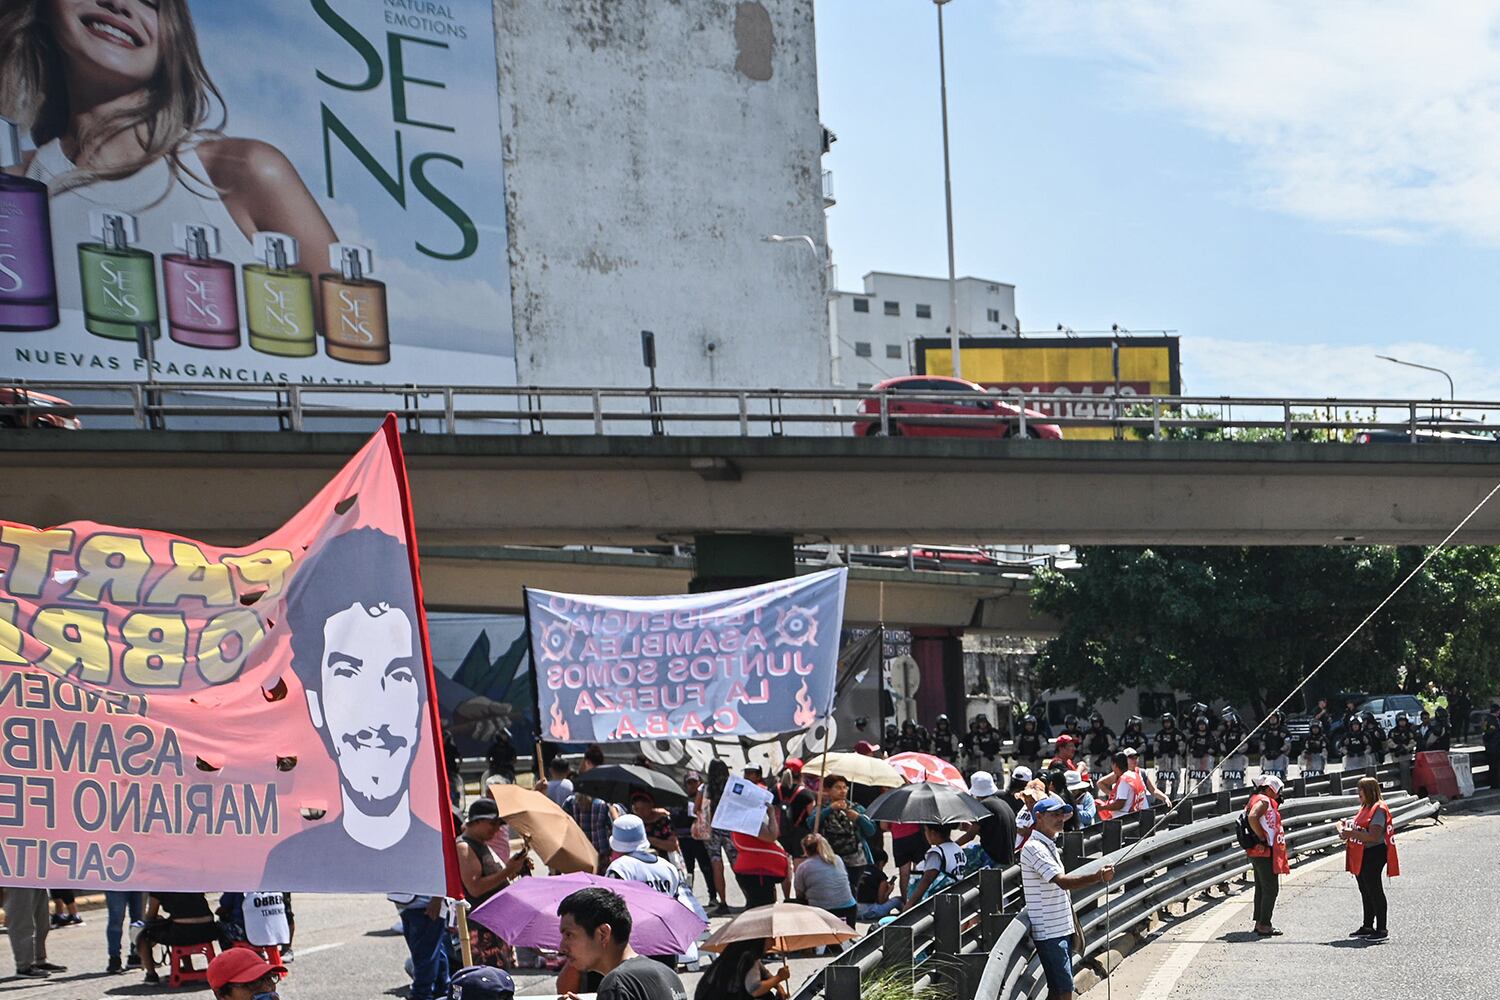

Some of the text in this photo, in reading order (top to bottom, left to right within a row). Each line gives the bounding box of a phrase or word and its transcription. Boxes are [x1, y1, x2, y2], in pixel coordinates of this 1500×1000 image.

[384, 10, 467, 39] EMOTIONS
[15, 348, 289, 384] NUEVAS FRAGANCIAS
[1158, 772, 1175, 780] PNA
[1190, 771, 1206, 779] PNA
[1224, 771, 1241, 779] PNA
